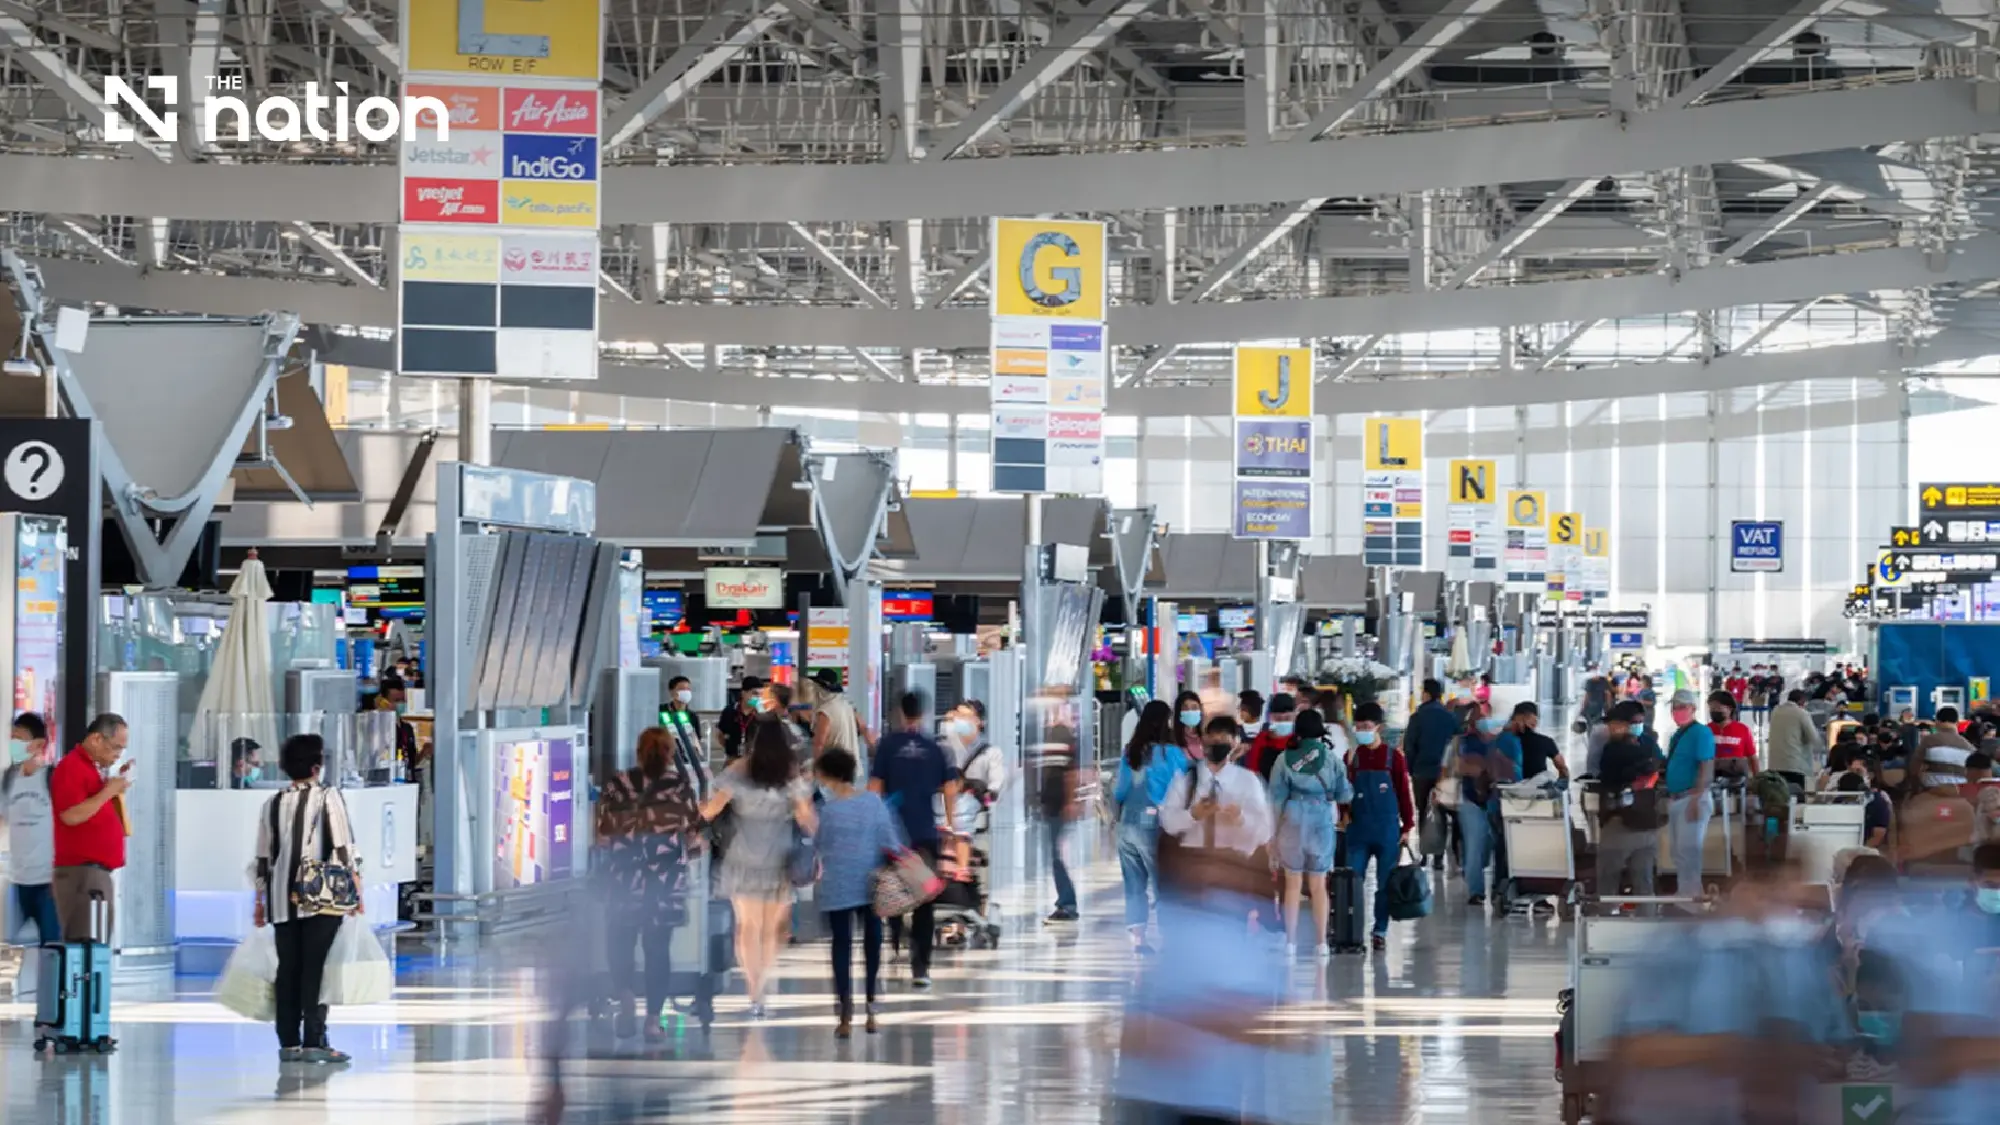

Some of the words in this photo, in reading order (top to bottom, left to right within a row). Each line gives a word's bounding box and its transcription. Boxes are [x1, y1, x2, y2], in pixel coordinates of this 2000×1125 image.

[468, 56, 505, 71] ROW
[513, 58, 537, 74] E/F
[407, 147, 471, 164] Jetstar
[511, 155, 586, 179] IndiGo
[1020, 232, 1081, 308] G
[1258, 355, 1290, 410] J
[1265, 436, 1307, 453] THAI
[1379, 423, 1407, 466] L
[1460, 465, 1486, 500] N
[1514, 494, 1539, 524] Q
[1557, 515, 1575, 542] S
[1740, 527, 1776, 544] VAT
[1585, 532, 1602, 555] U
[1737, 546, 1776, 556] REFUND
